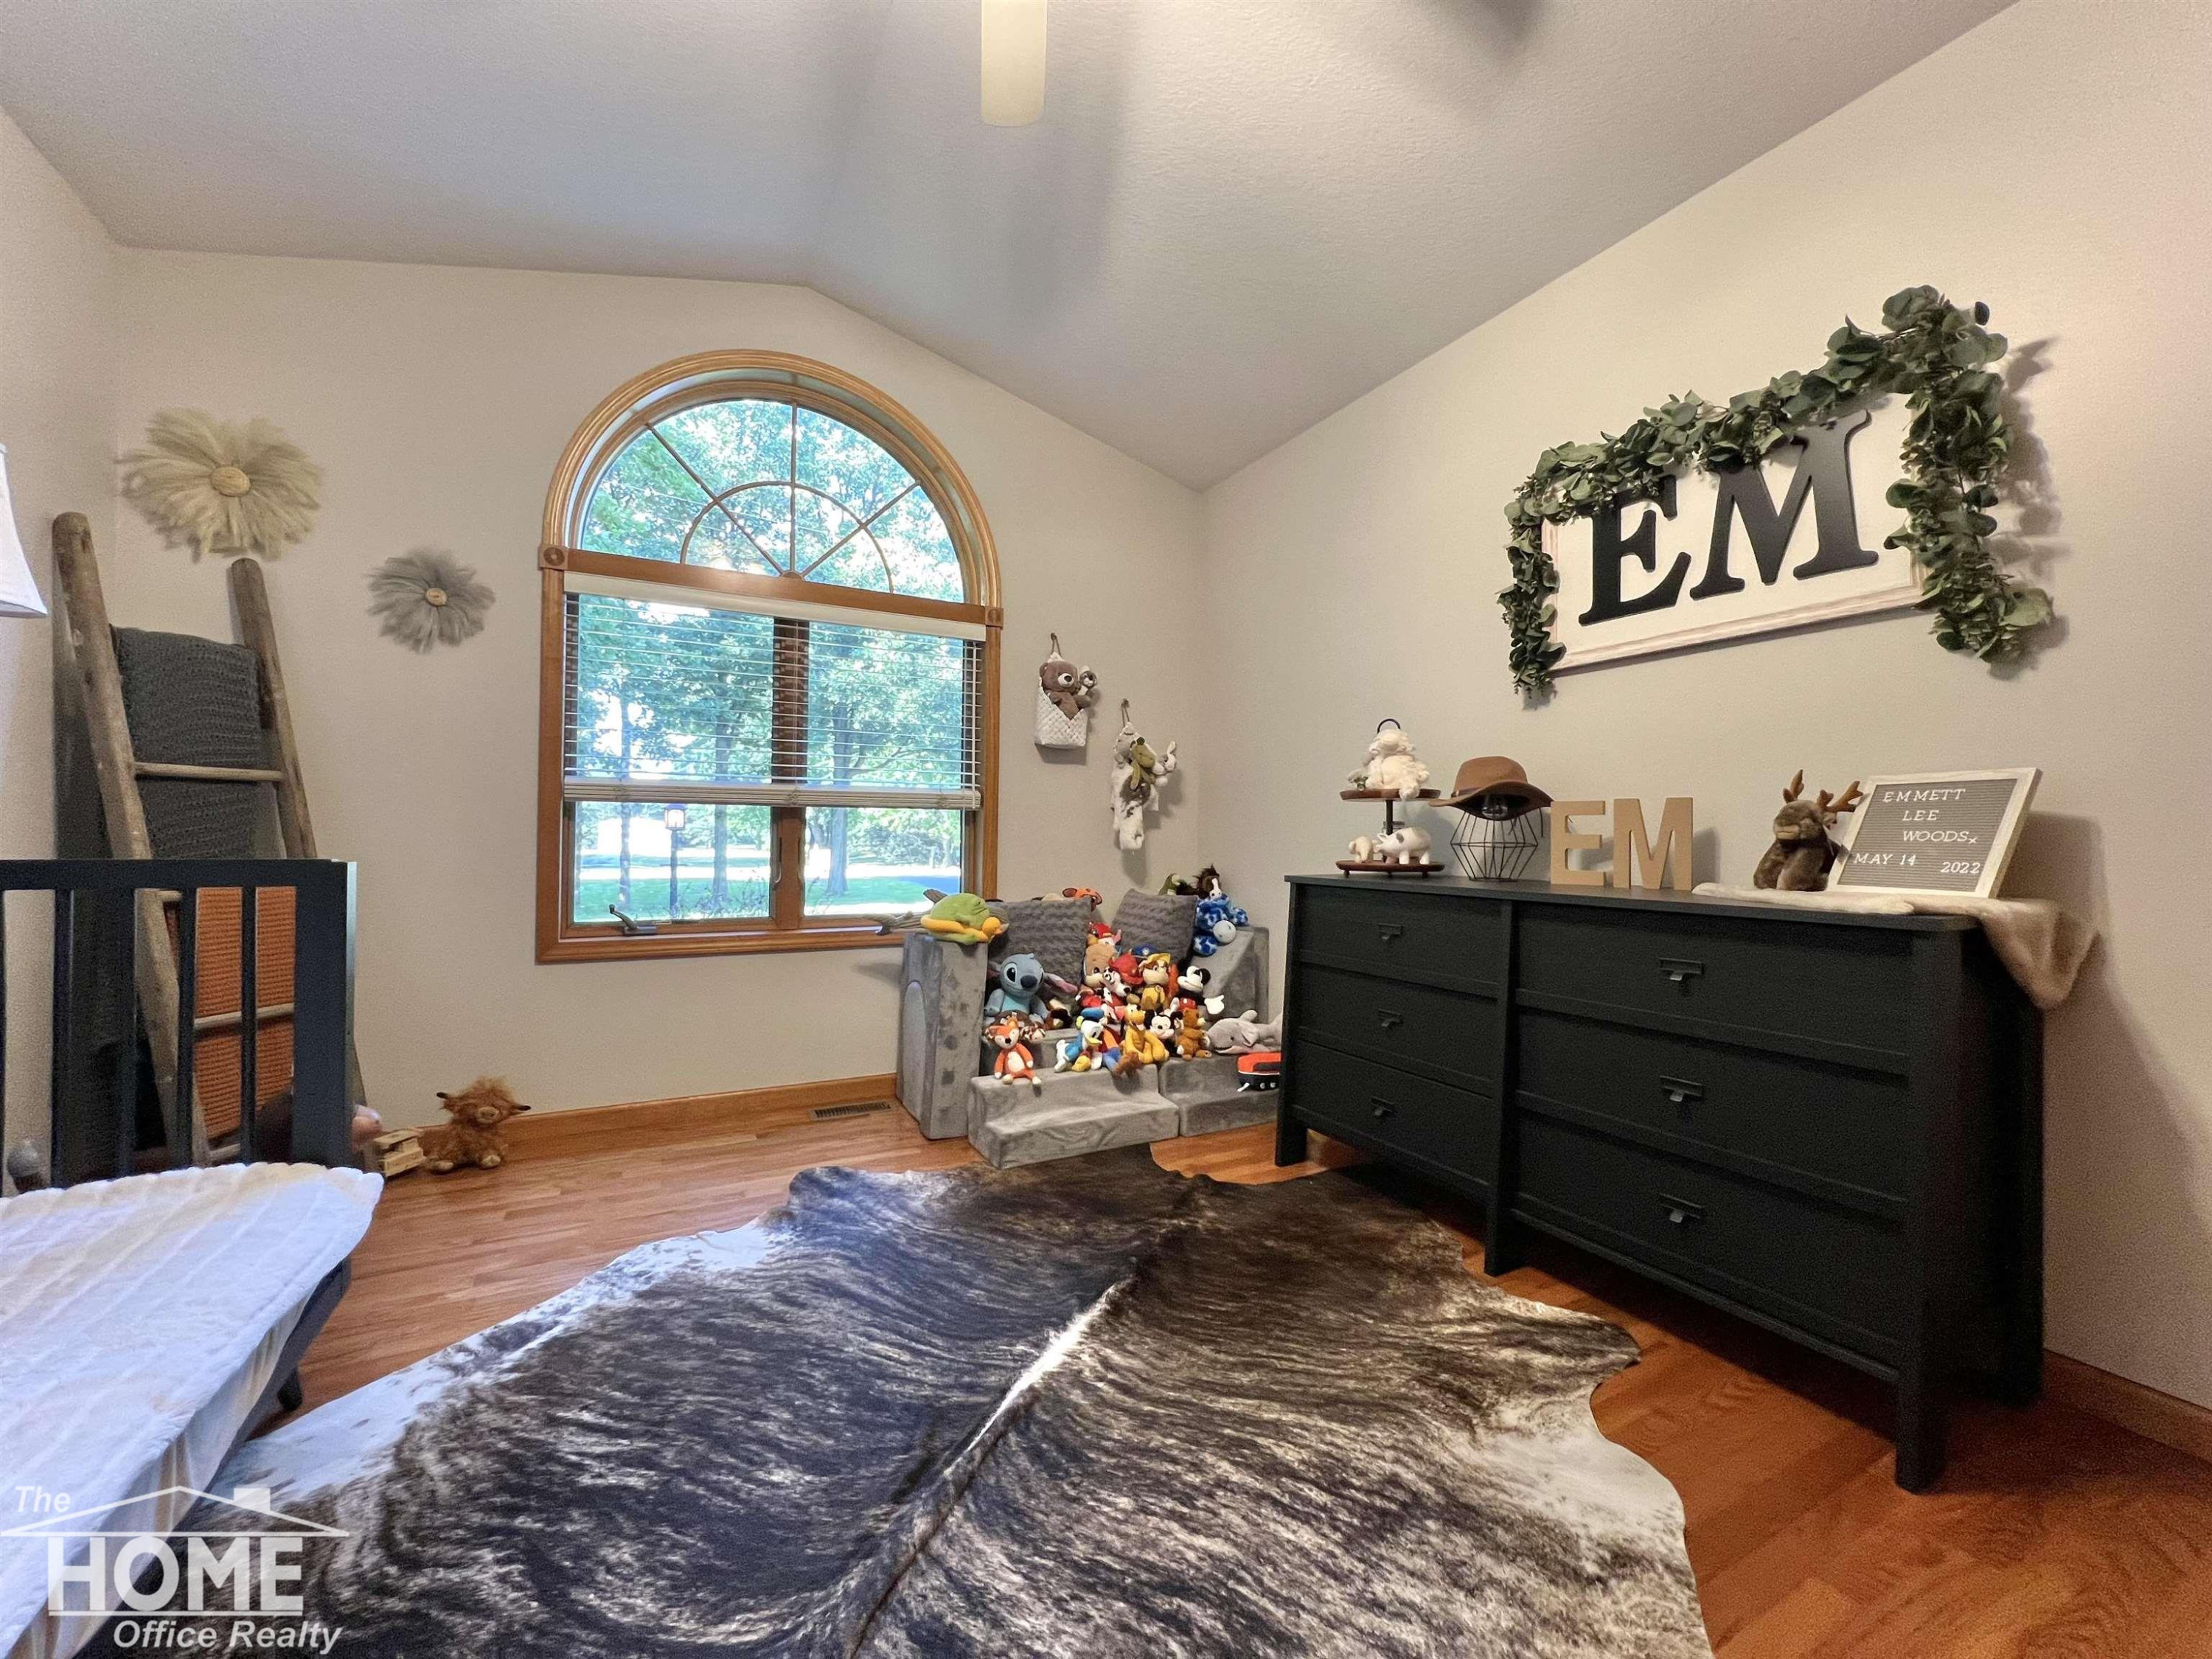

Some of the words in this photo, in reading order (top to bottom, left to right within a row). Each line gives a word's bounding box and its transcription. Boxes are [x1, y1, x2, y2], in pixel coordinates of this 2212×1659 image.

[1577, 408, 1879, 627] EM
[1882, 788, 1966, 803] EMMETT
[1902, 810, 1940, 821] LEE
[1551, 796, 1694, 891] EM
[1853, 852, 1893, 865] MAY
[1899, 853, 1916, 866] 14
[1940, 861, 1981, 874] 2022
